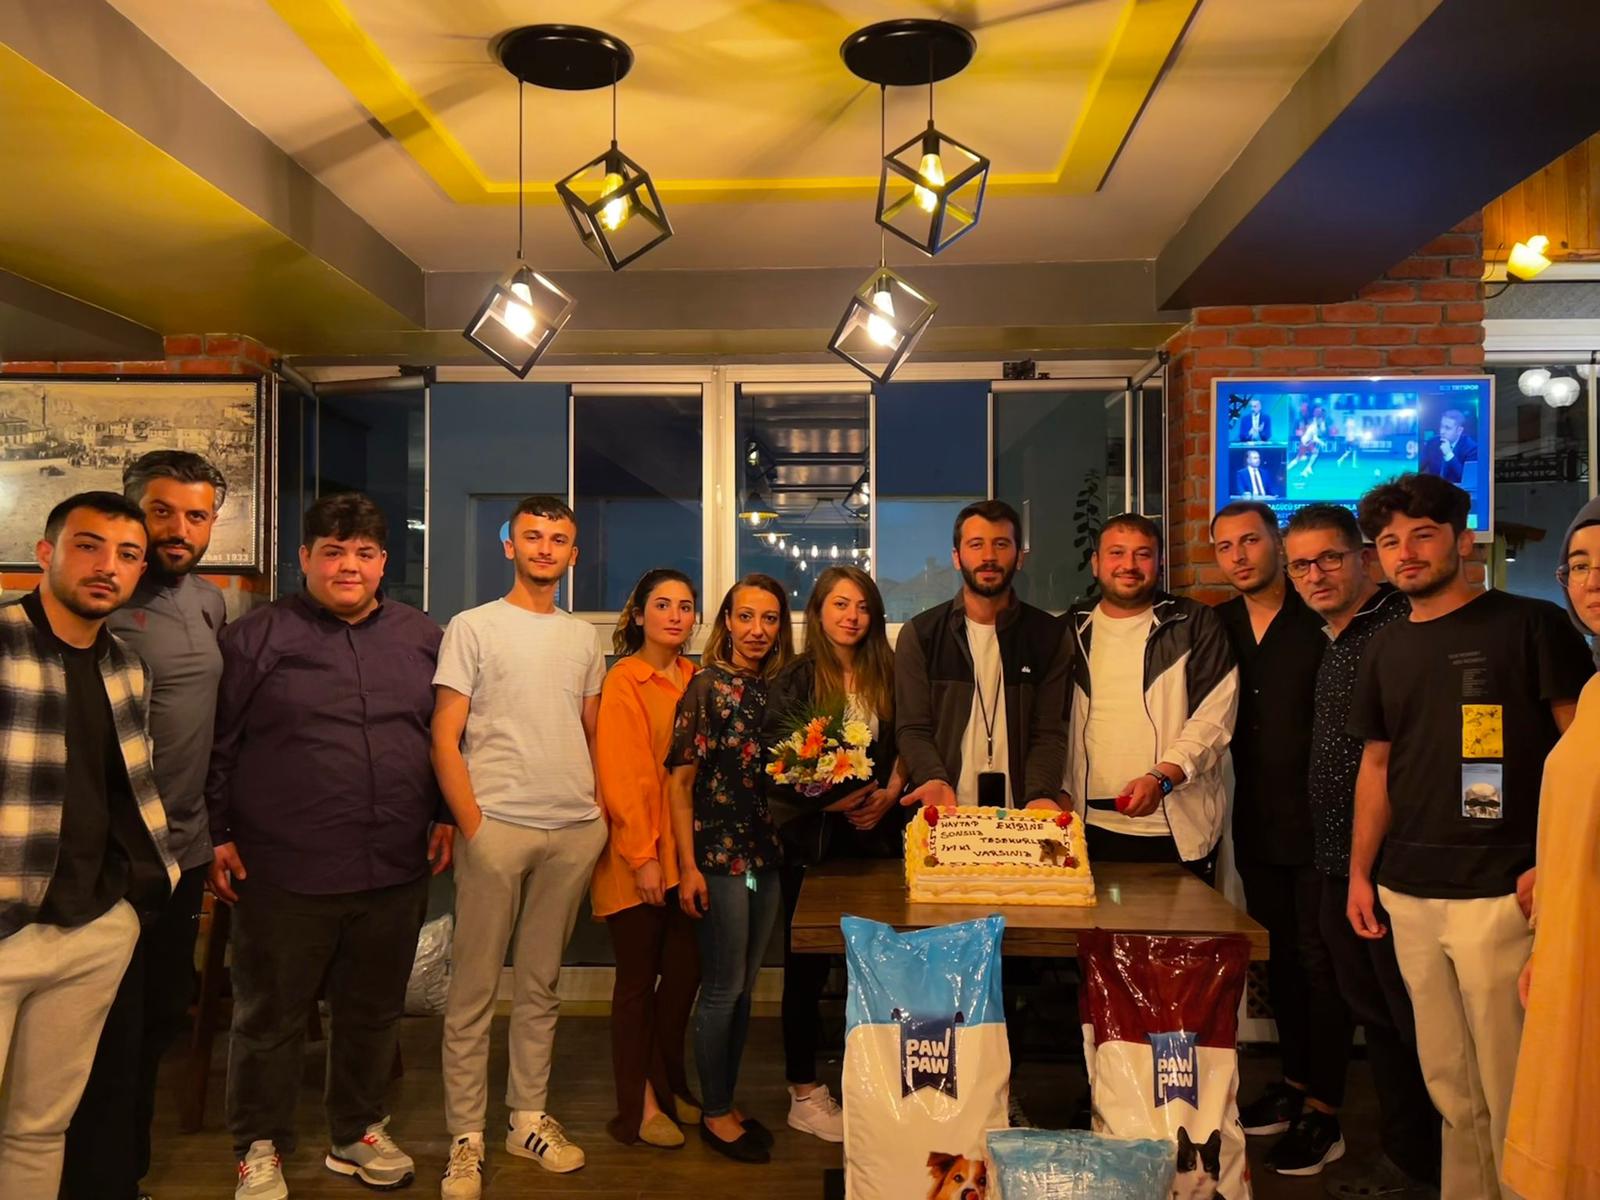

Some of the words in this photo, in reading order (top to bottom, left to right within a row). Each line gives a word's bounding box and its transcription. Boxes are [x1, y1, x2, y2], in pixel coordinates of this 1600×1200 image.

[906, 1027, 951, 1057] PAW
[906, 1055, 949, 1087] PAW
[1157, 1046, 1193, 1072] PAW
[1157, 1072, 1193, 1099] PAW
